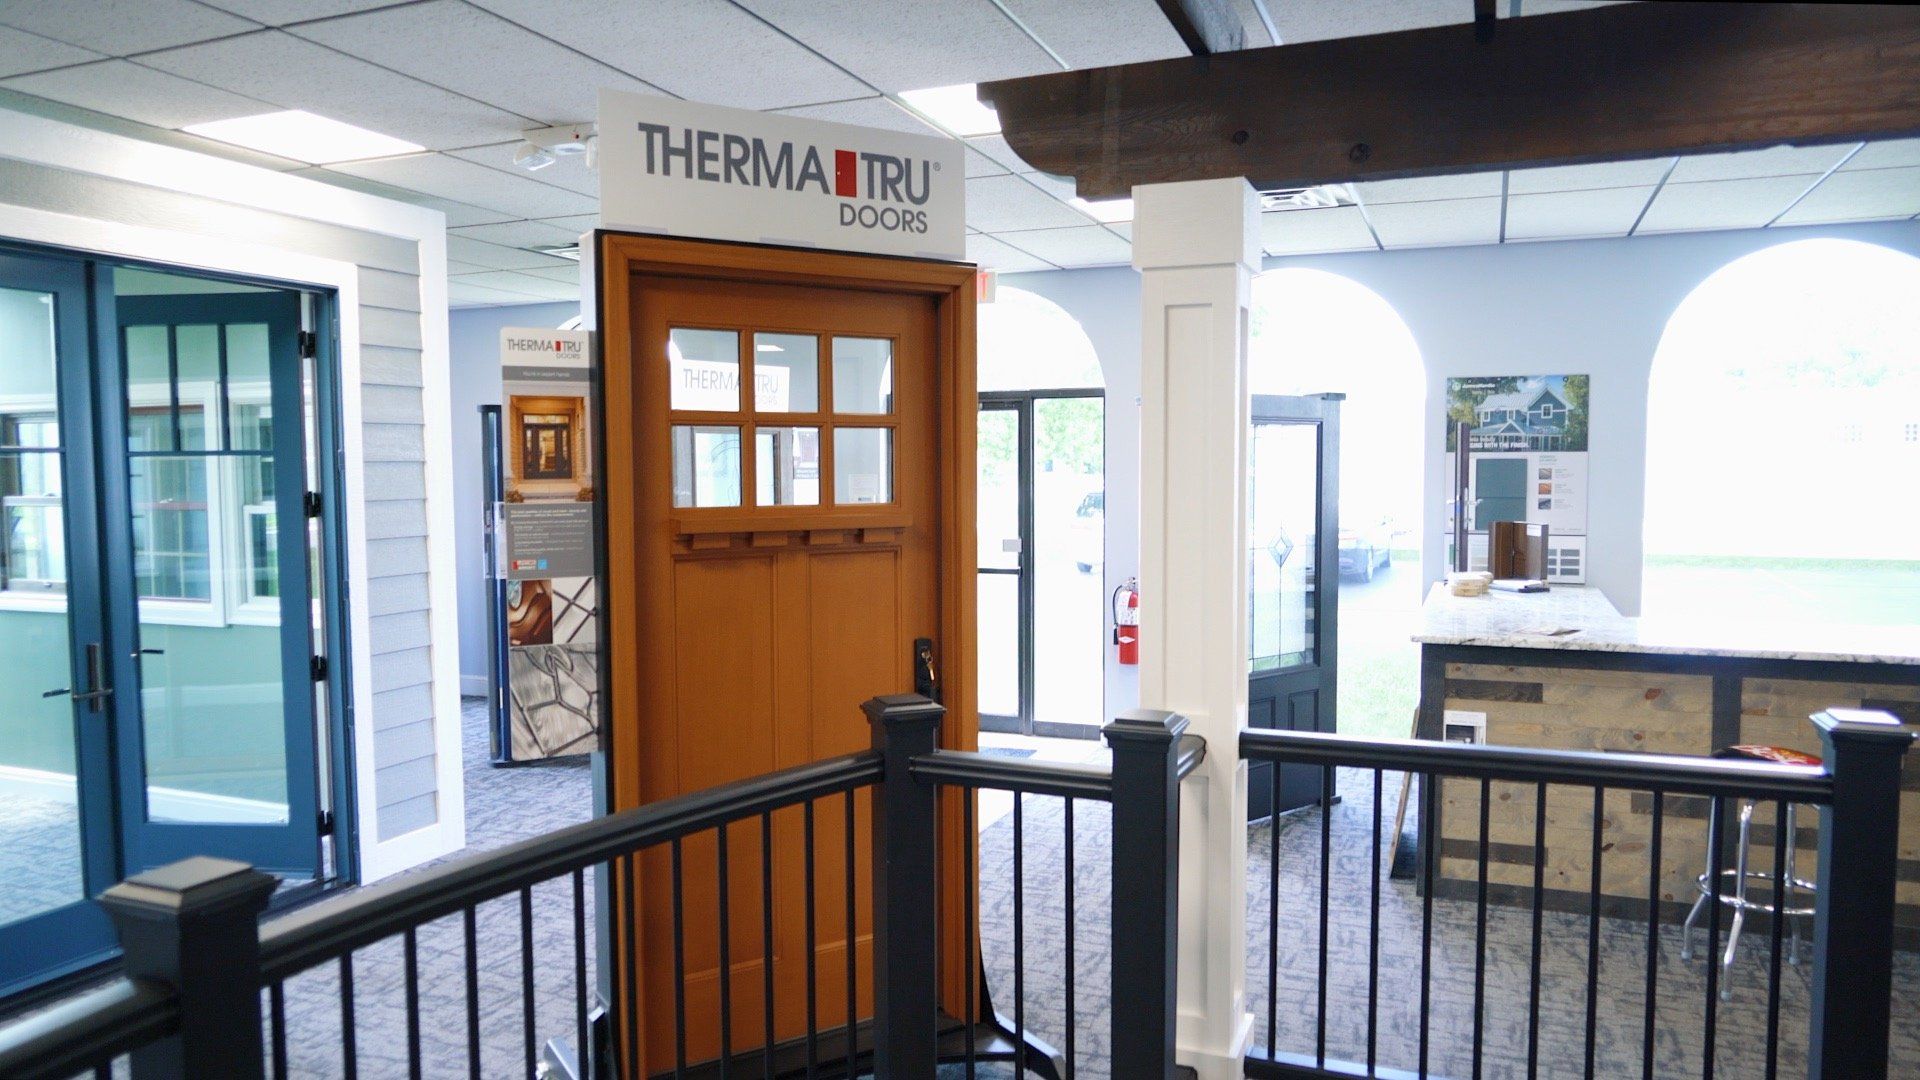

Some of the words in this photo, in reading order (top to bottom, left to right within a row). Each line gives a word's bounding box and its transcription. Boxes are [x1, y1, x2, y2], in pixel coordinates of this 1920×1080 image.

[638, 122, 831, 195] THERMA
[860, 152, 930, 205] TRU
[839, 203, 929, 234] DOORS
[507, 338, 554, 352] THERMA
[562, 340, 581, 352] TRU
